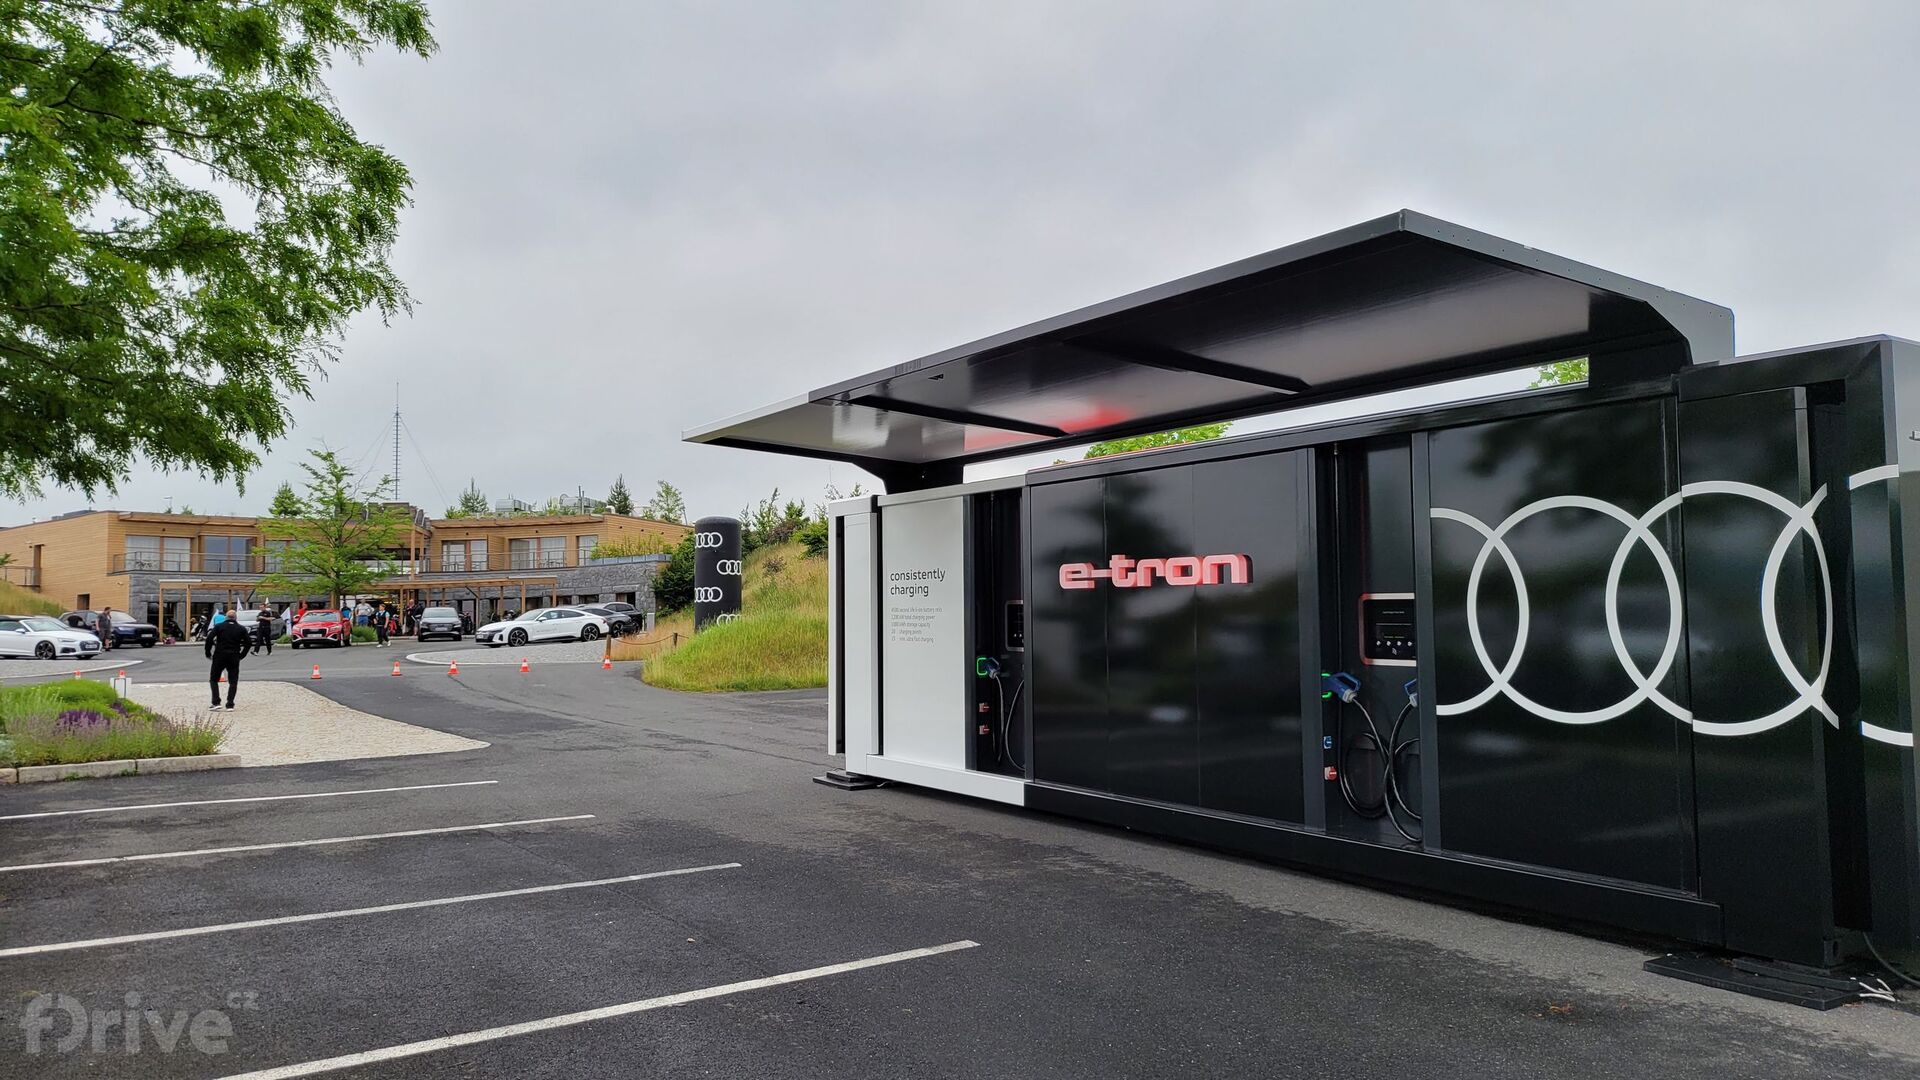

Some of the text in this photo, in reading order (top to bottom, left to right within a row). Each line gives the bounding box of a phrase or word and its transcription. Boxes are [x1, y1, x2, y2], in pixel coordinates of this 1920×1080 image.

[890, 568, 946, 582] consistently
[1059, 554, 1250, 589] e-tron
[890, 583, 929, 597] charging
